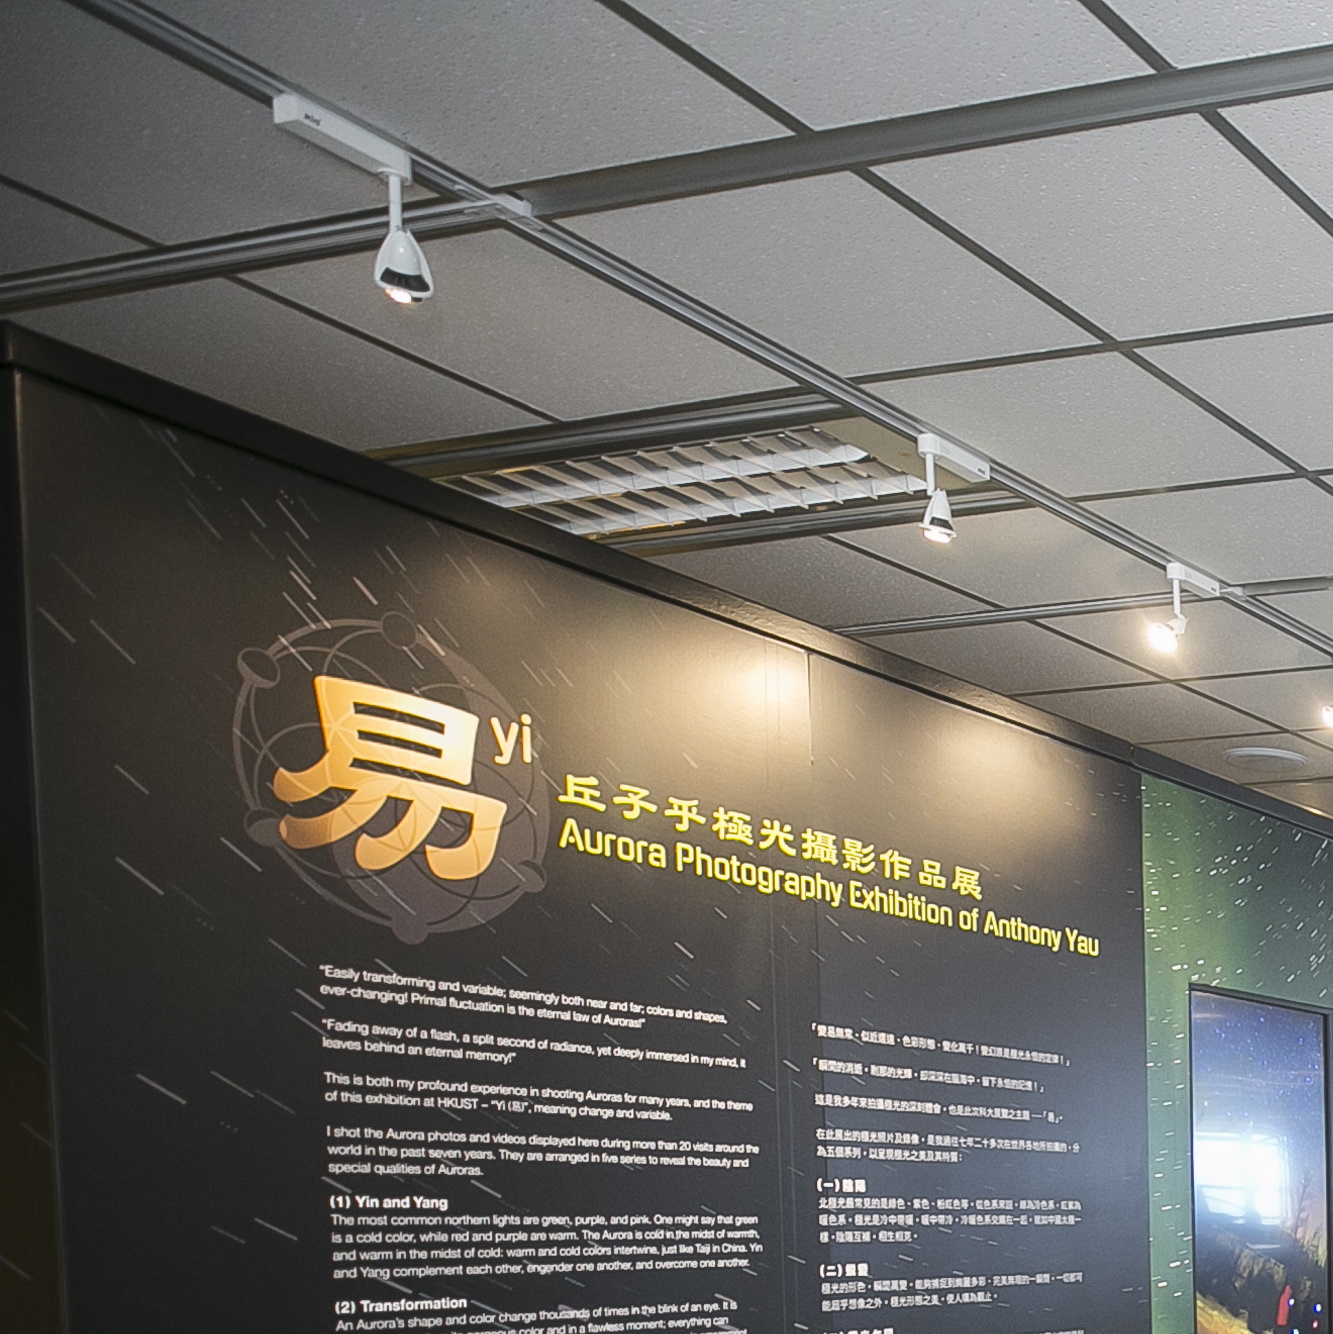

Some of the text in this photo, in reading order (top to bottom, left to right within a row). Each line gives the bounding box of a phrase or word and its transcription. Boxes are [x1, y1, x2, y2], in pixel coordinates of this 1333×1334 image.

[490, 713, 532, 765] yi
[273, 675, 507, 880] 易
[558, 774, 982, 900] 丘子乎極光攝影作品展
[559, 818, 1100, 957] Aurora Photography Exhibition of Anthony Yau
[363, 971, 436, 991] transforming
[438, 981, 460, 991] and
[509, 990, 559, 1005] seemingly
[562, 994, 584, 1006] both
[587, 999, 607, 1008] near
[609, 1002, 628, 1011] and
[646, 1006, 674, 1017] colors
[676, 1010, 692, 1019] and
[694, 1011, 727, 1024] shapes,
[411, 993, 447, 1007] Primal
[449, 997, 504, 1013] fluctuation
[518, 1006, 535, 1016] the
[537, 1009, 571, 1020] eternal
[573, 1011, 590, 1022] law
[323, 1036, 362, 1050] leaves
[364, 1040, 405, 1054] behind
[408, 1046, 422, 1055] an
[425, 1047, 463, 1058] eternal
[372, 1025, 403, 1039] away
[430, 1029, 460, 1042] flash,
[473, 1034, 494, 1045] split
[497, 1037, 535, 1049] second
[550, 1042, 594, 1055] radiance,
[597, 1046, 611, 1056] yet
[613, 1047, 644, 1060] deeply
[646, 1050, 689, 1063] immersed
[715, 1057, 738, 1068] mind,
[340, 1092, 363, 1103] this
[365, 1094, 420, 1106] exhibition
[437, 1097, 478, 1109] HKUST
[534, 1105, 577, 1117] meaning
[579, 1106, 614, 1119] change
[616, 1109, 634, 1118] and
[636, 1110, 672, 1120] variable.
[329, 1163, 371, 1174] special
[374, 1164, 421, 1175] qualities
[438, 1164, 483, 1175] Auroras.
[330, 1196, 448, 1211] (1) Yin and Yang
[335, 1297, 467, 1314] (2) Transformation
